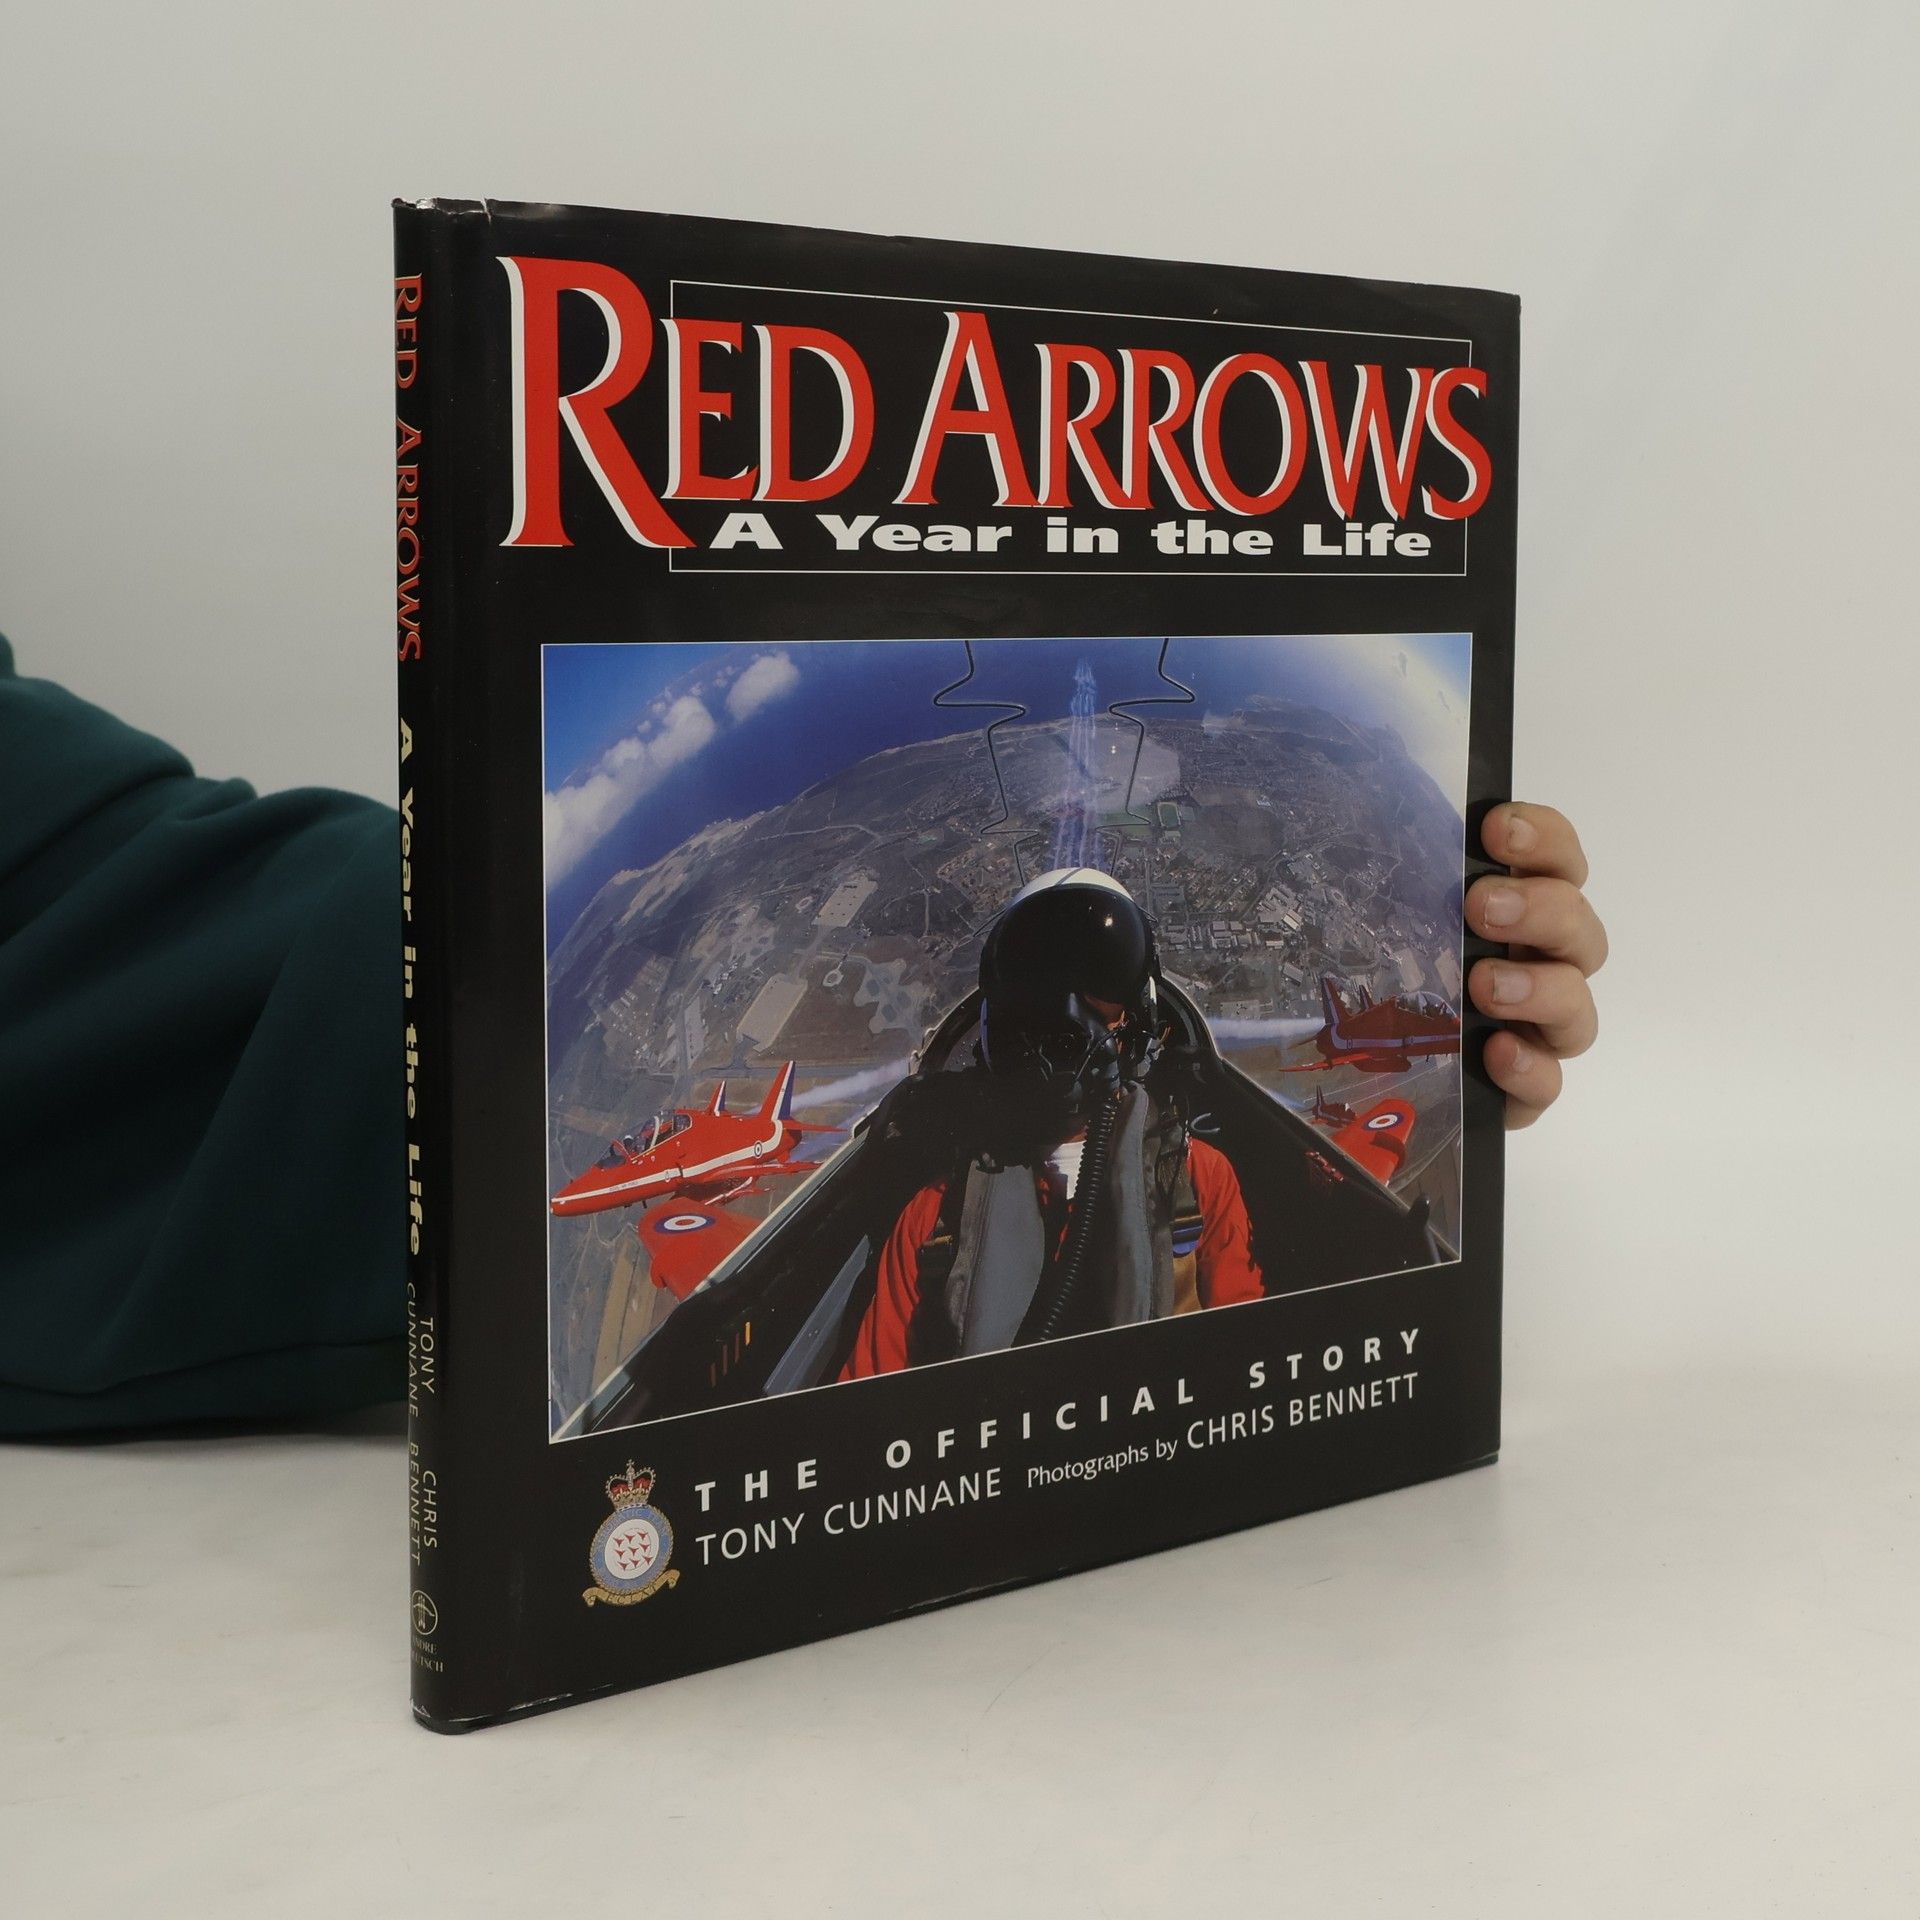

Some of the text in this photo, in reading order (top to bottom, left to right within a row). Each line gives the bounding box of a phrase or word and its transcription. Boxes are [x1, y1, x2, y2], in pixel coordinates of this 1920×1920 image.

[394, 272, 423, 662] RED ARROWS
[496, 256, 1492, 549] RED ARROWS
[709, 512, 1432, 557] A Year in the Life
[401, 718, 423, 1256] A Year in the Life
[407, 1282, 419, 1418] CUNNANE
[420, 1317, 435, 1394] TONY
[695, 1328, 1419, 1512] THE OFFICIAL STORY
[409, 1441, 421, 1566] BENNETT
[423, 1470, 437, 1548] CHRIS
[695, 1512, 805, 1565] TONY
[824, 1467, 1001, 1535] CUNNANE
[1027, 1444, 1149, 1488] Photographs
[1155, 1439, 1178, 1461] by
[1186, 1404, 1274, 1449] CHRIS
[1289, 1372, 1419, 1427] BENNETT
